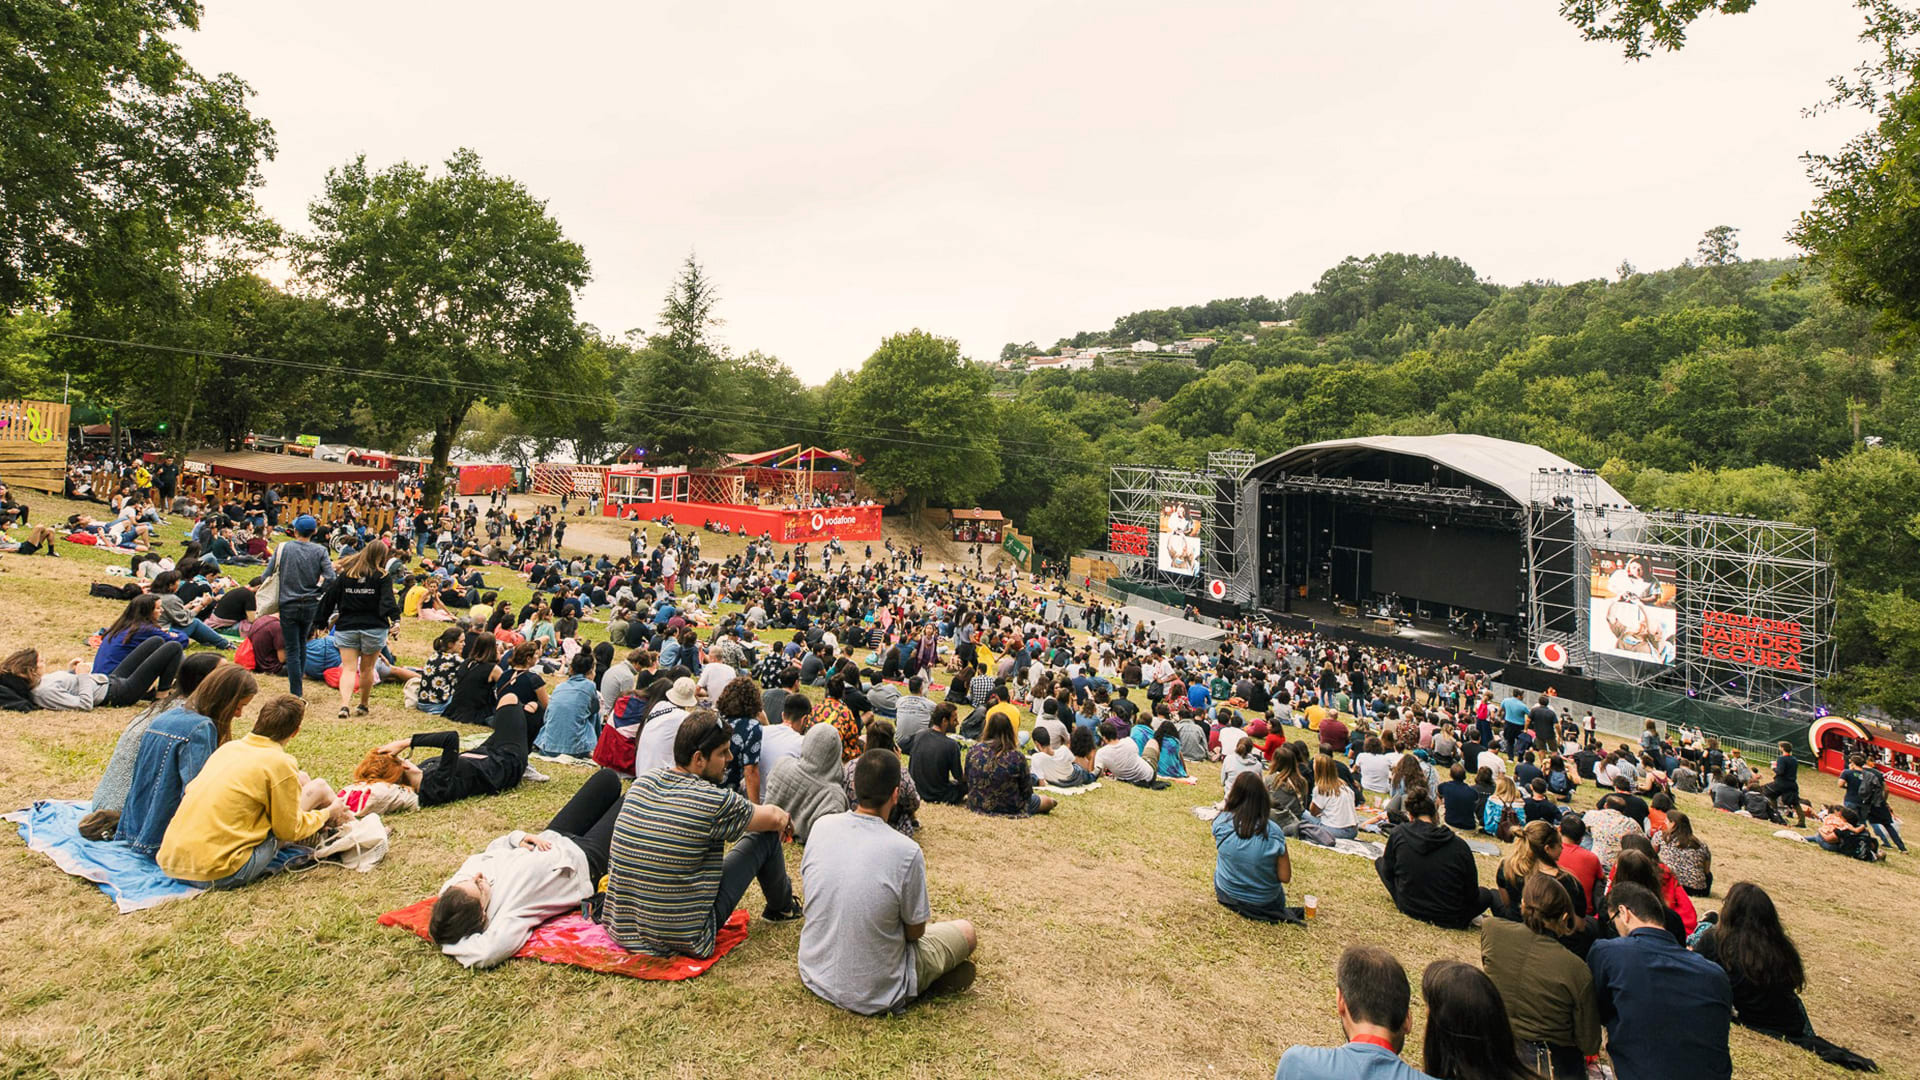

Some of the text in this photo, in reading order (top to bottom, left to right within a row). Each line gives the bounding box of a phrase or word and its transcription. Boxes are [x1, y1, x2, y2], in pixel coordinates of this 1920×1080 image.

[824, 514, 856, 526] vodafone
[1703, 610, 1801, 636] VODAFONE
[1702, 623, 1802, 654] PAREDES
[1712, 642, 1803, 673] COURA
